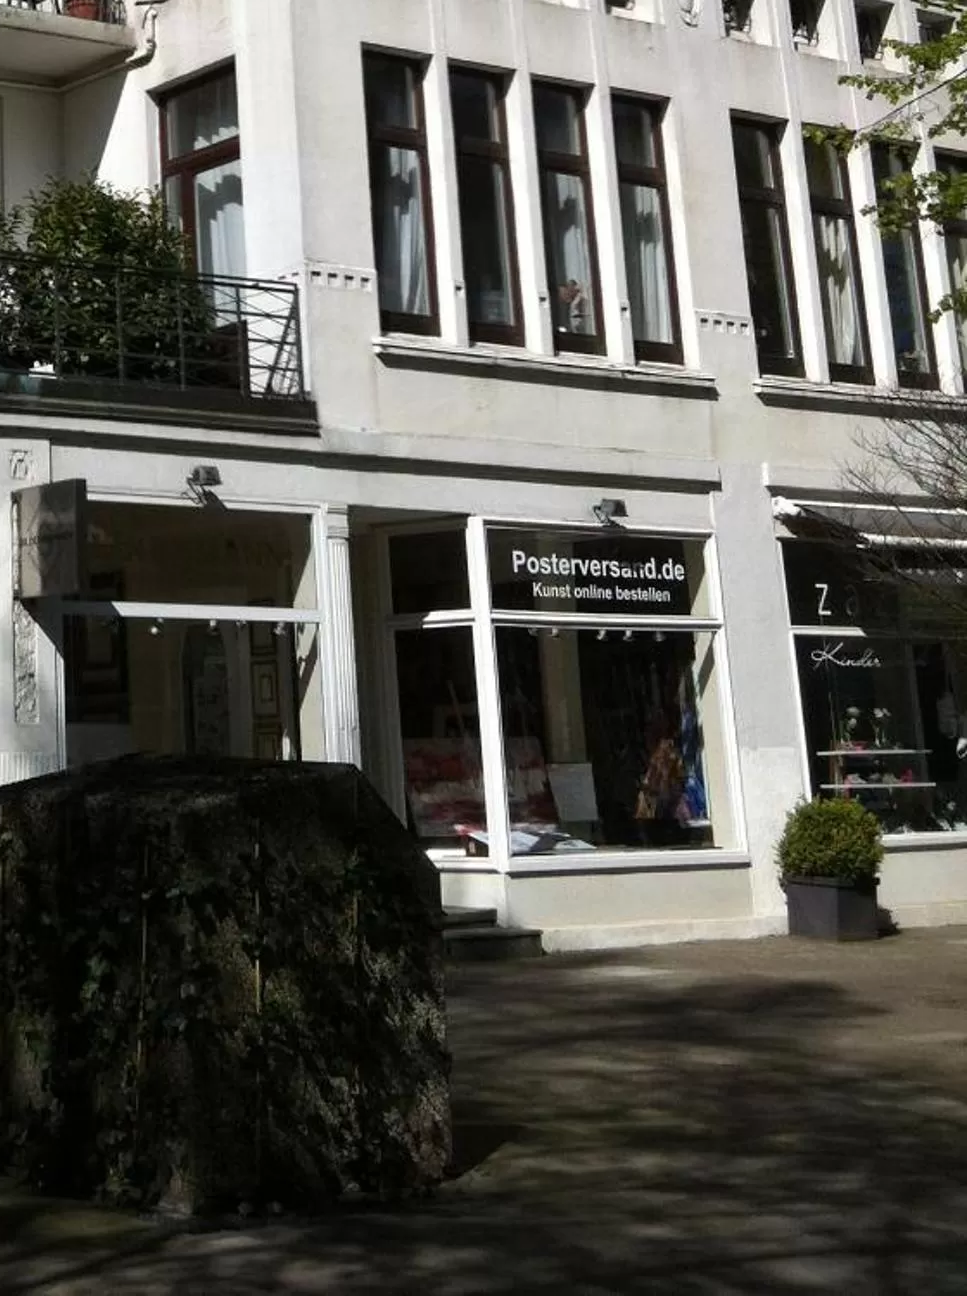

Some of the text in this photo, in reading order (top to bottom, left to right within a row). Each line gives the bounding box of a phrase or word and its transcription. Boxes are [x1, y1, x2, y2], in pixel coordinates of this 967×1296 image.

[511, 549, 685, 581] Posterversand.de
[532, 582, 671, 603] Kunst online bestellen
